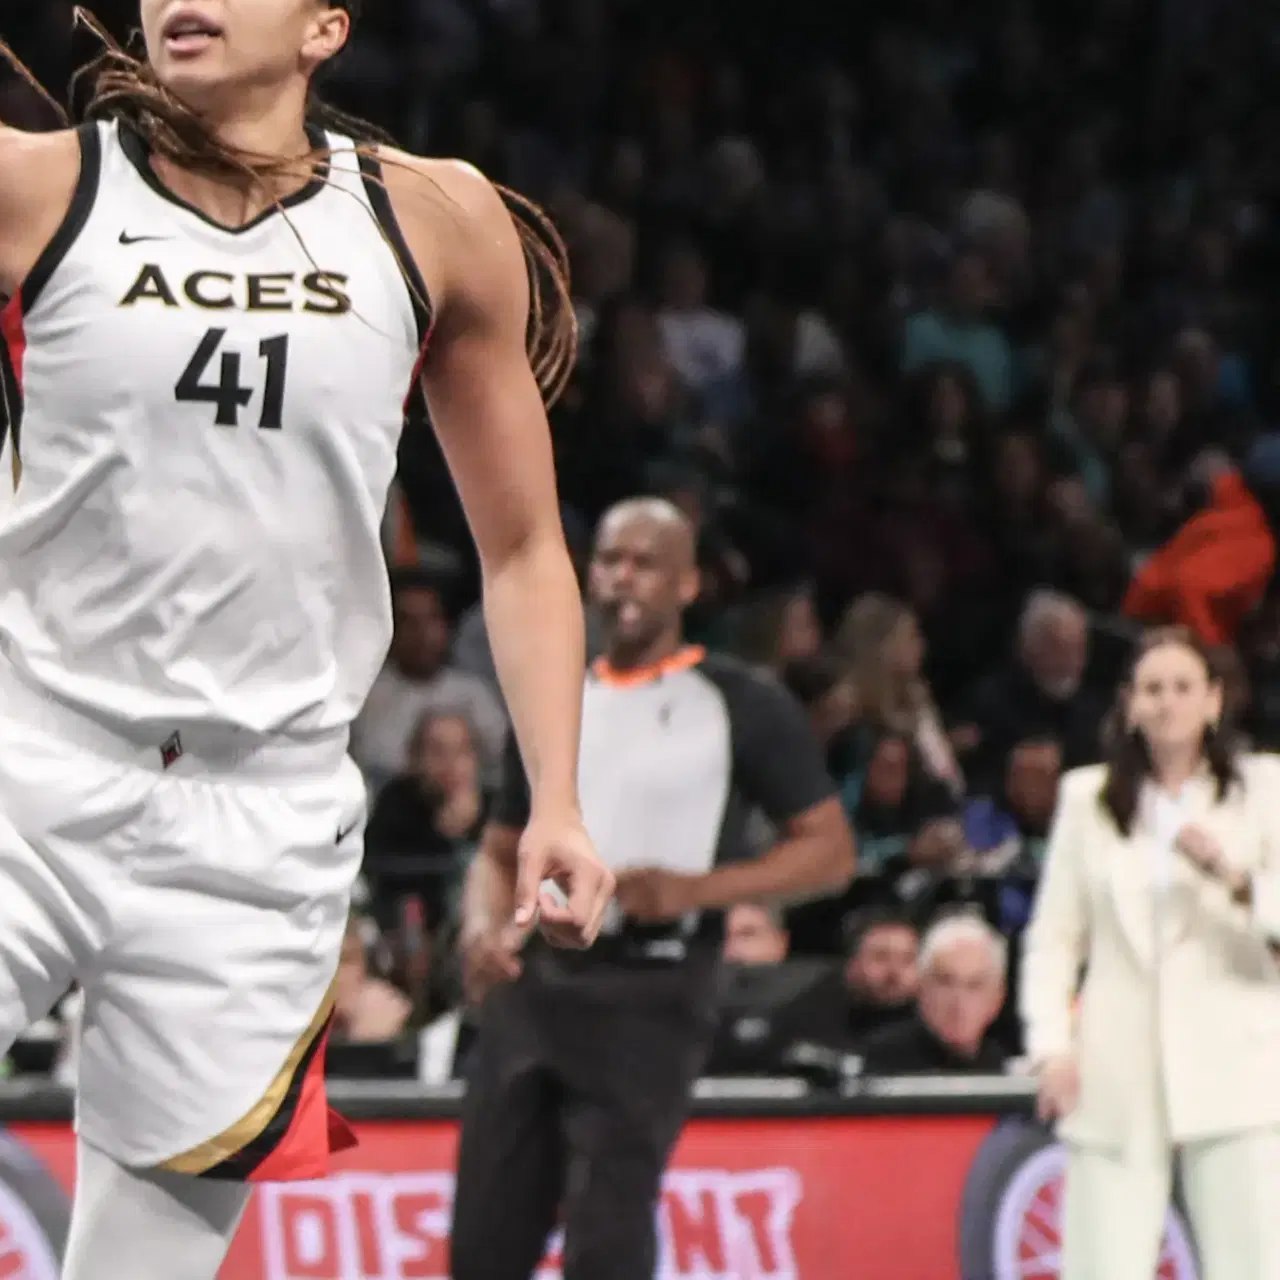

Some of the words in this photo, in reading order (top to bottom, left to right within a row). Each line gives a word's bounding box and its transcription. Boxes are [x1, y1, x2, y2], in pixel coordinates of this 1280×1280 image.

[117, 263, 352, 315] ACES
[174, 327, 289, 429] 41
[260, 1167, 802, 1280] DISNT
